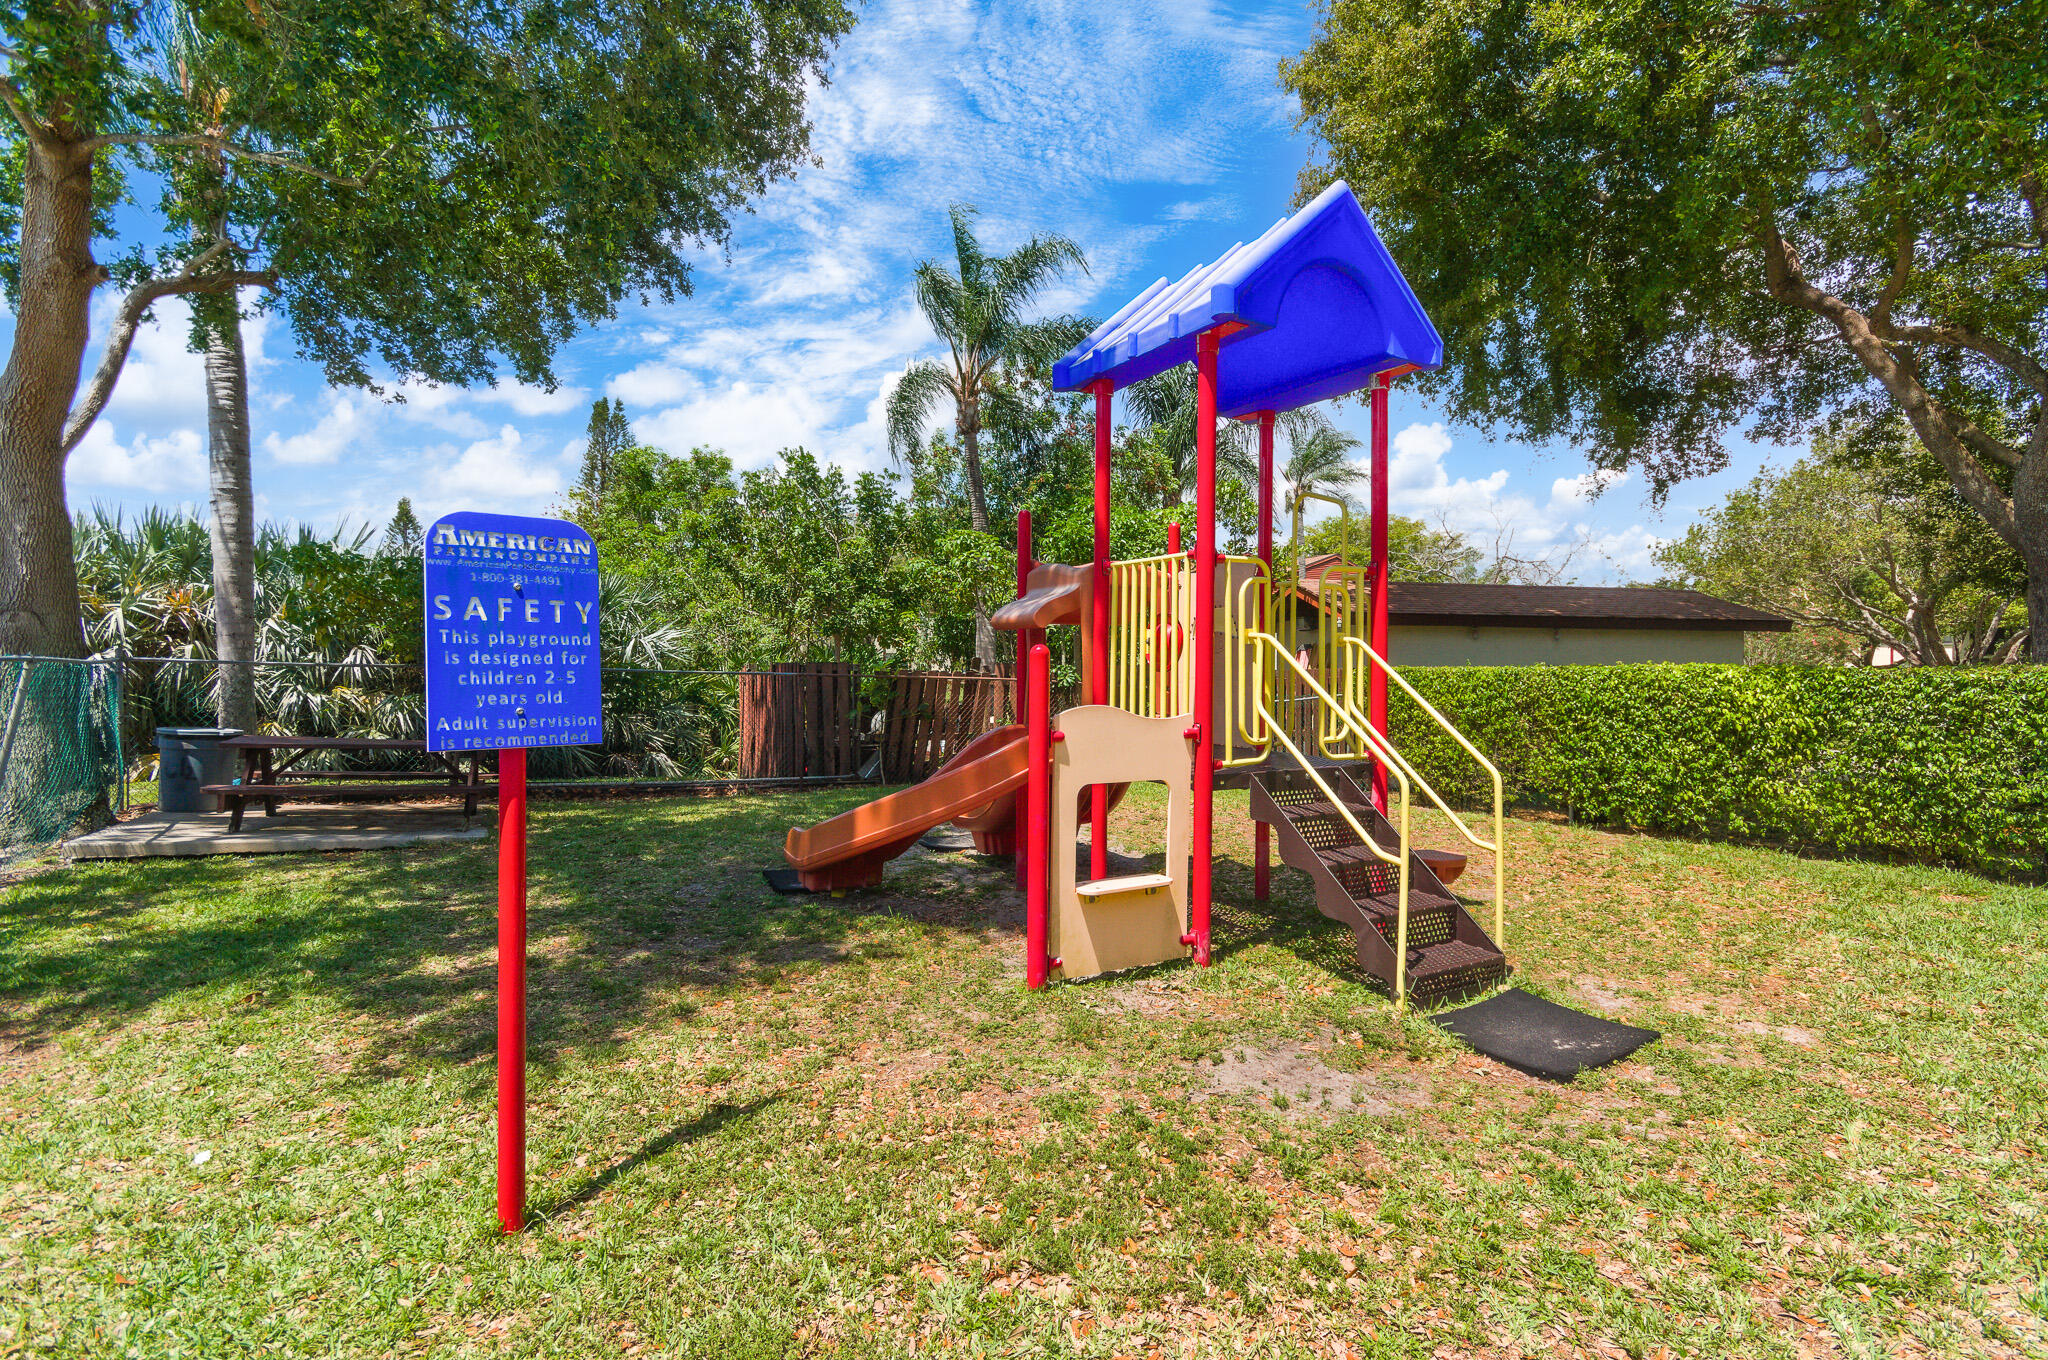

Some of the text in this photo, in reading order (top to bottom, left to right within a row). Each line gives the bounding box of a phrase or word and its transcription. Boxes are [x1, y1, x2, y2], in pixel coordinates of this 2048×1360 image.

[433, 545, 491, 560] PARKS
[470, 572, 561, 586] 1-800-381-4491
[433, 594, 594, 624] SAFETY
[438, 629, 592, 648] This playground
[444, 650, 588, 667] is designed for
[458, 670, 577, 686] children 2-5
[475, 692, 528, 708] years
[436, 713, 597, 732] Adult supervision
[440, 735, 456, 750] is
